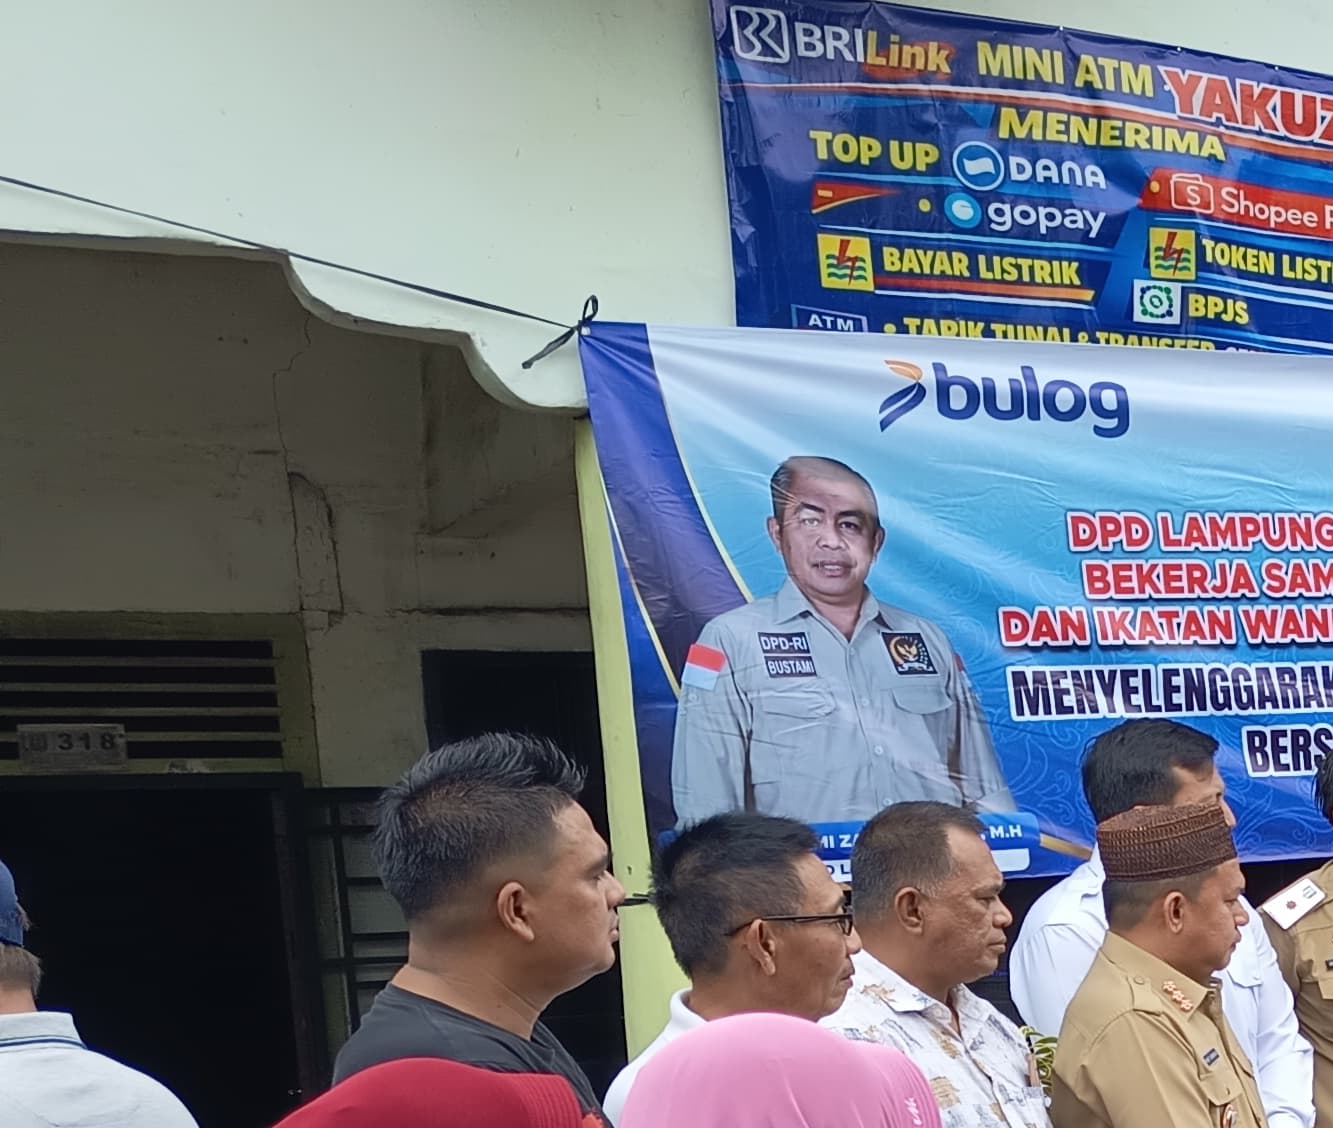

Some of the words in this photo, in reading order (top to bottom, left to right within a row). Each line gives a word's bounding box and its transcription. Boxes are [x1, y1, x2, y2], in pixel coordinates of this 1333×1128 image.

[795, 22, 951, 74] BRILink
[977, 41, 1065, 85] MINI
[1075, 54, 1154, 97] ATM
[809, 130, 882, 166] TOP
[889, 140, 940, 171] UP
[998, 107, 1227, 161] MENERIMA
[1009, 156, 1107, 189] DANA
[988, 202, 1106, 238] gopay
[1221, 187, 1318, 228] Shopee
[882, 246, 970, 277] BAYAR
[979, 254, 1081, 285] LISTRIK
[1202, 238, 1275, 276] TOKEN
[808, 313, 854, 332] ATM
[1188, 294, 1249, 325] BPJS
[931, 362, 1130, 439] bulog
[1068, 514, 1151, 549] DPD
[1085, 563, 1257, 596] BEKERJA
[760, 636, 807, 650] DPD-RI
[1001, 609, 1085, 644] DAN
[1098, 609, 1234, 643] IKATAN
[768, 660, 814, 675] BUSTAMI
